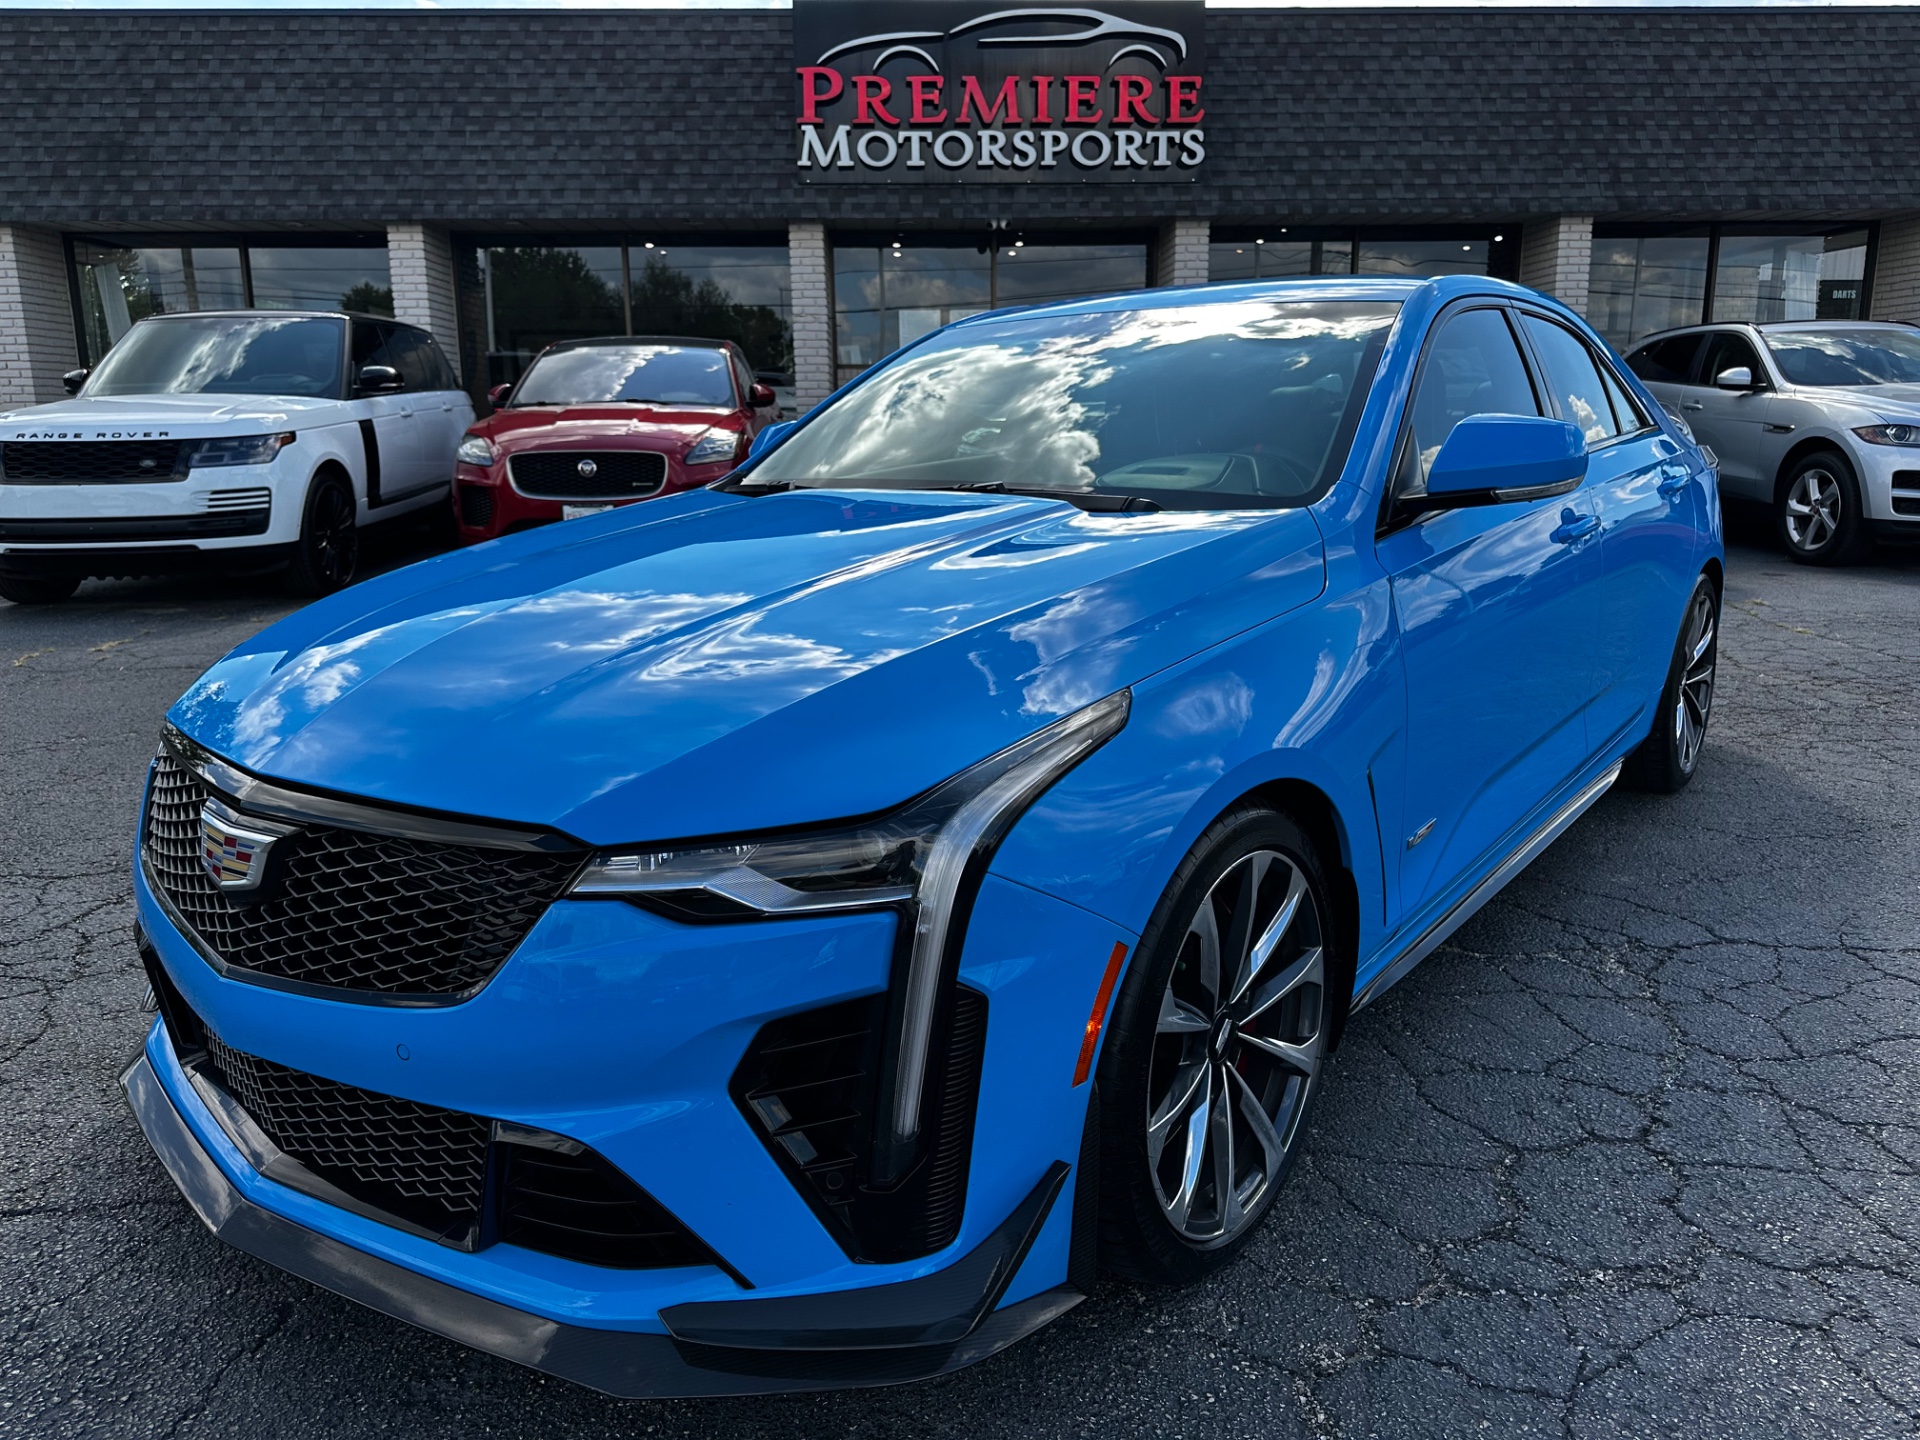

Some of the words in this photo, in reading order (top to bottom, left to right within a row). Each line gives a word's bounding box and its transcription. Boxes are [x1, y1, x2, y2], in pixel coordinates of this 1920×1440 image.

[796, 67, 1205, 125] PREMIERE
[797, 125, 1206, 168] MOTORSPORTS
[1832, 290, 1857, 299] DARTS
[16, 432, 83, 440] RANGE
[96, 431, 170, 439] ROVER
